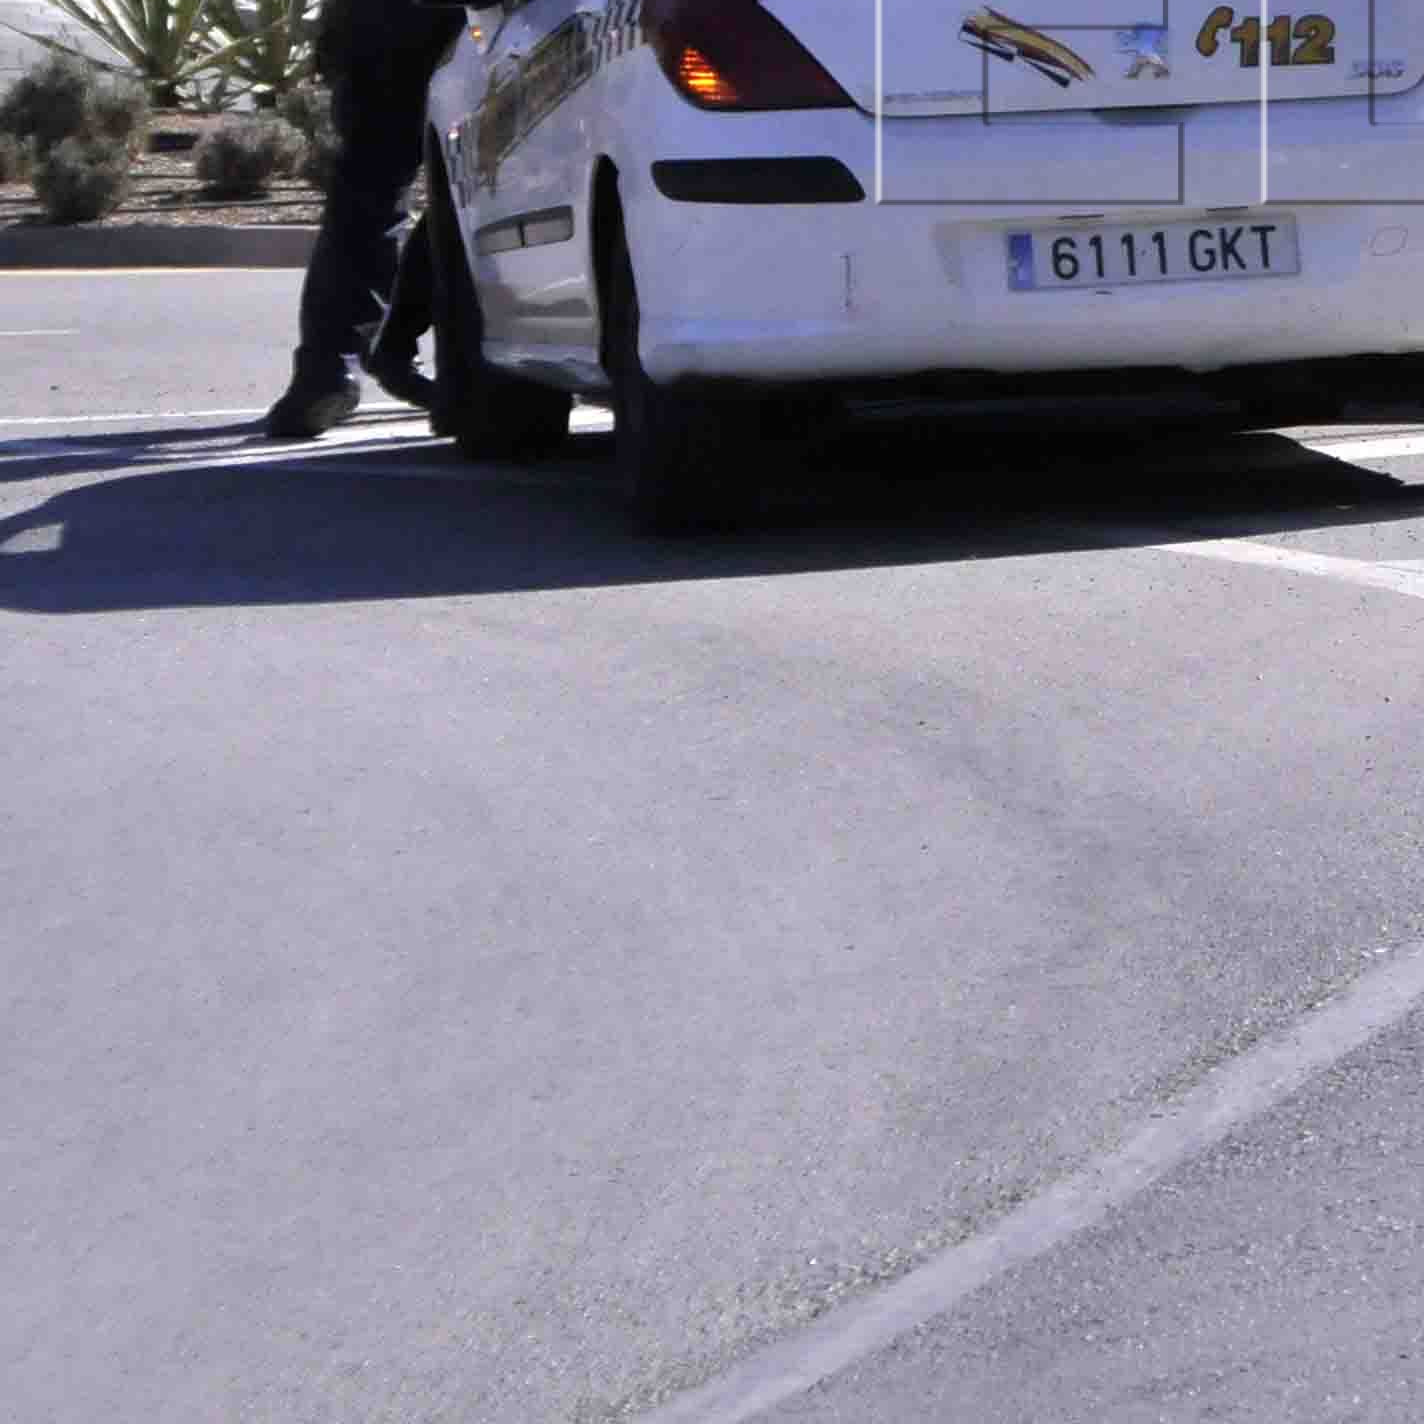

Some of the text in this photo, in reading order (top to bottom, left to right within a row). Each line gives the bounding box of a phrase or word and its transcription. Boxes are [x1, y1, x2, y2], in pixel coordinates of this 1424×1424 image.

[1230, 14, 1336, 68] 112
[1051, 224, 1277, 281] 6111 GKT
